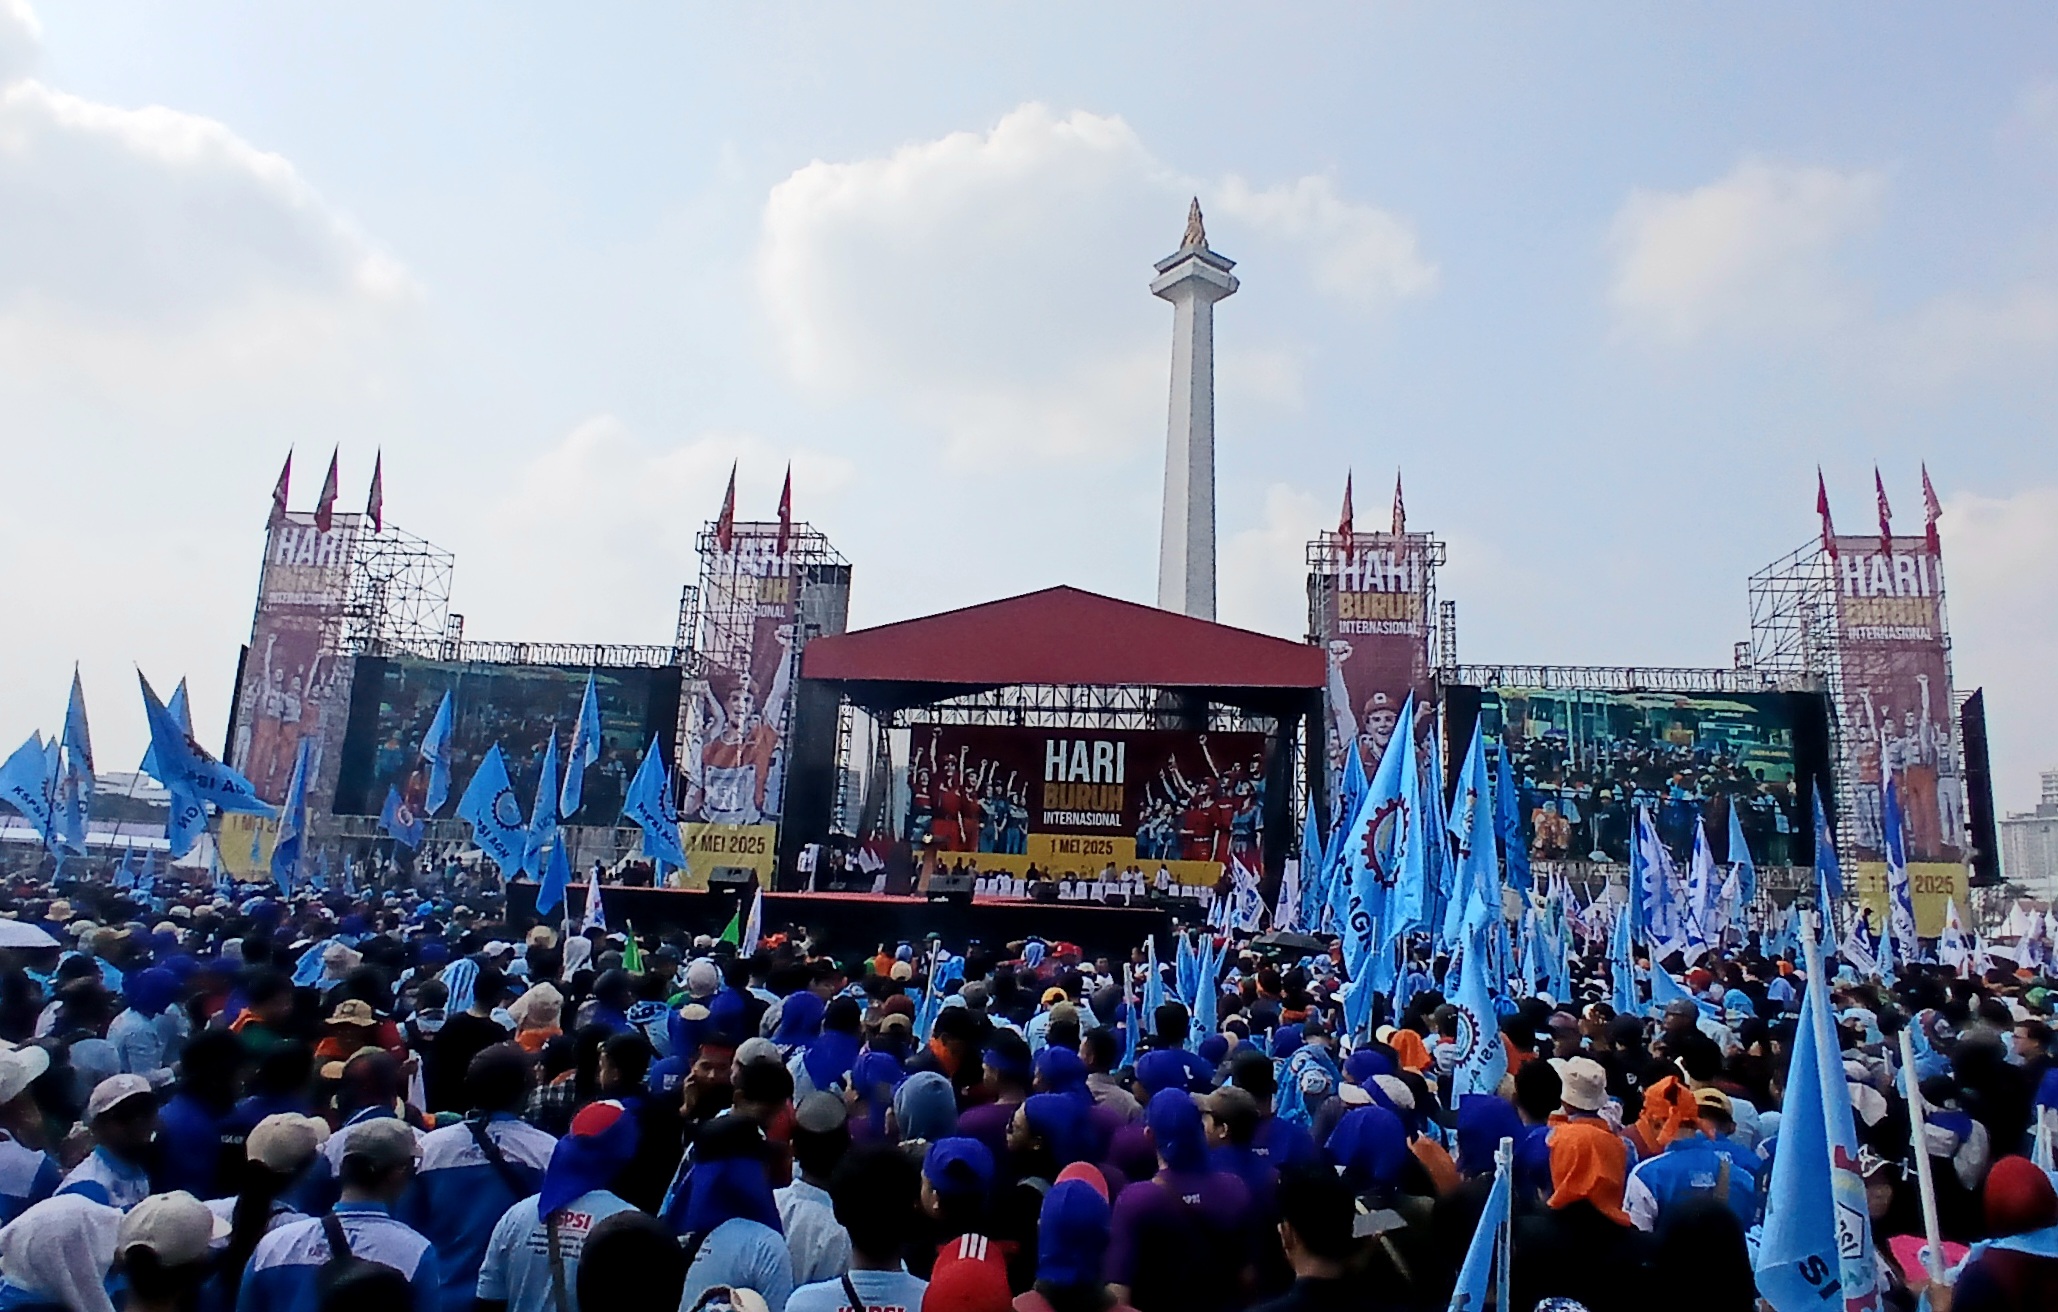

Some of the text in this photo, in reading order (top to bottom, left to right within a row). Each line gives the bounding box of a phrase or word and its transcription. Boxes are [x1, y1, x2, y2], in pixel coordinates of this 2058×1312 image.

[1338, 549, 1420, 592] HARI
[1841, 555, 1932, 597] HARI
[1338, 592, 1421, 620] BURUH
[1338, 620, 1420, 635] INTERNASIONAL
[1044, 739, 1125, 784] HARI
[1043, 783, 1124, 811] BURUH
[1043, 811, 1122, 827] INTERNASIONAL
[701, 835, 726, 852] MEI
[730, 836, 766, 855] 2025
[1051, 839, 1113, 855] 1 MEI 2025
[1915, 875, 1955, 895] 2025
